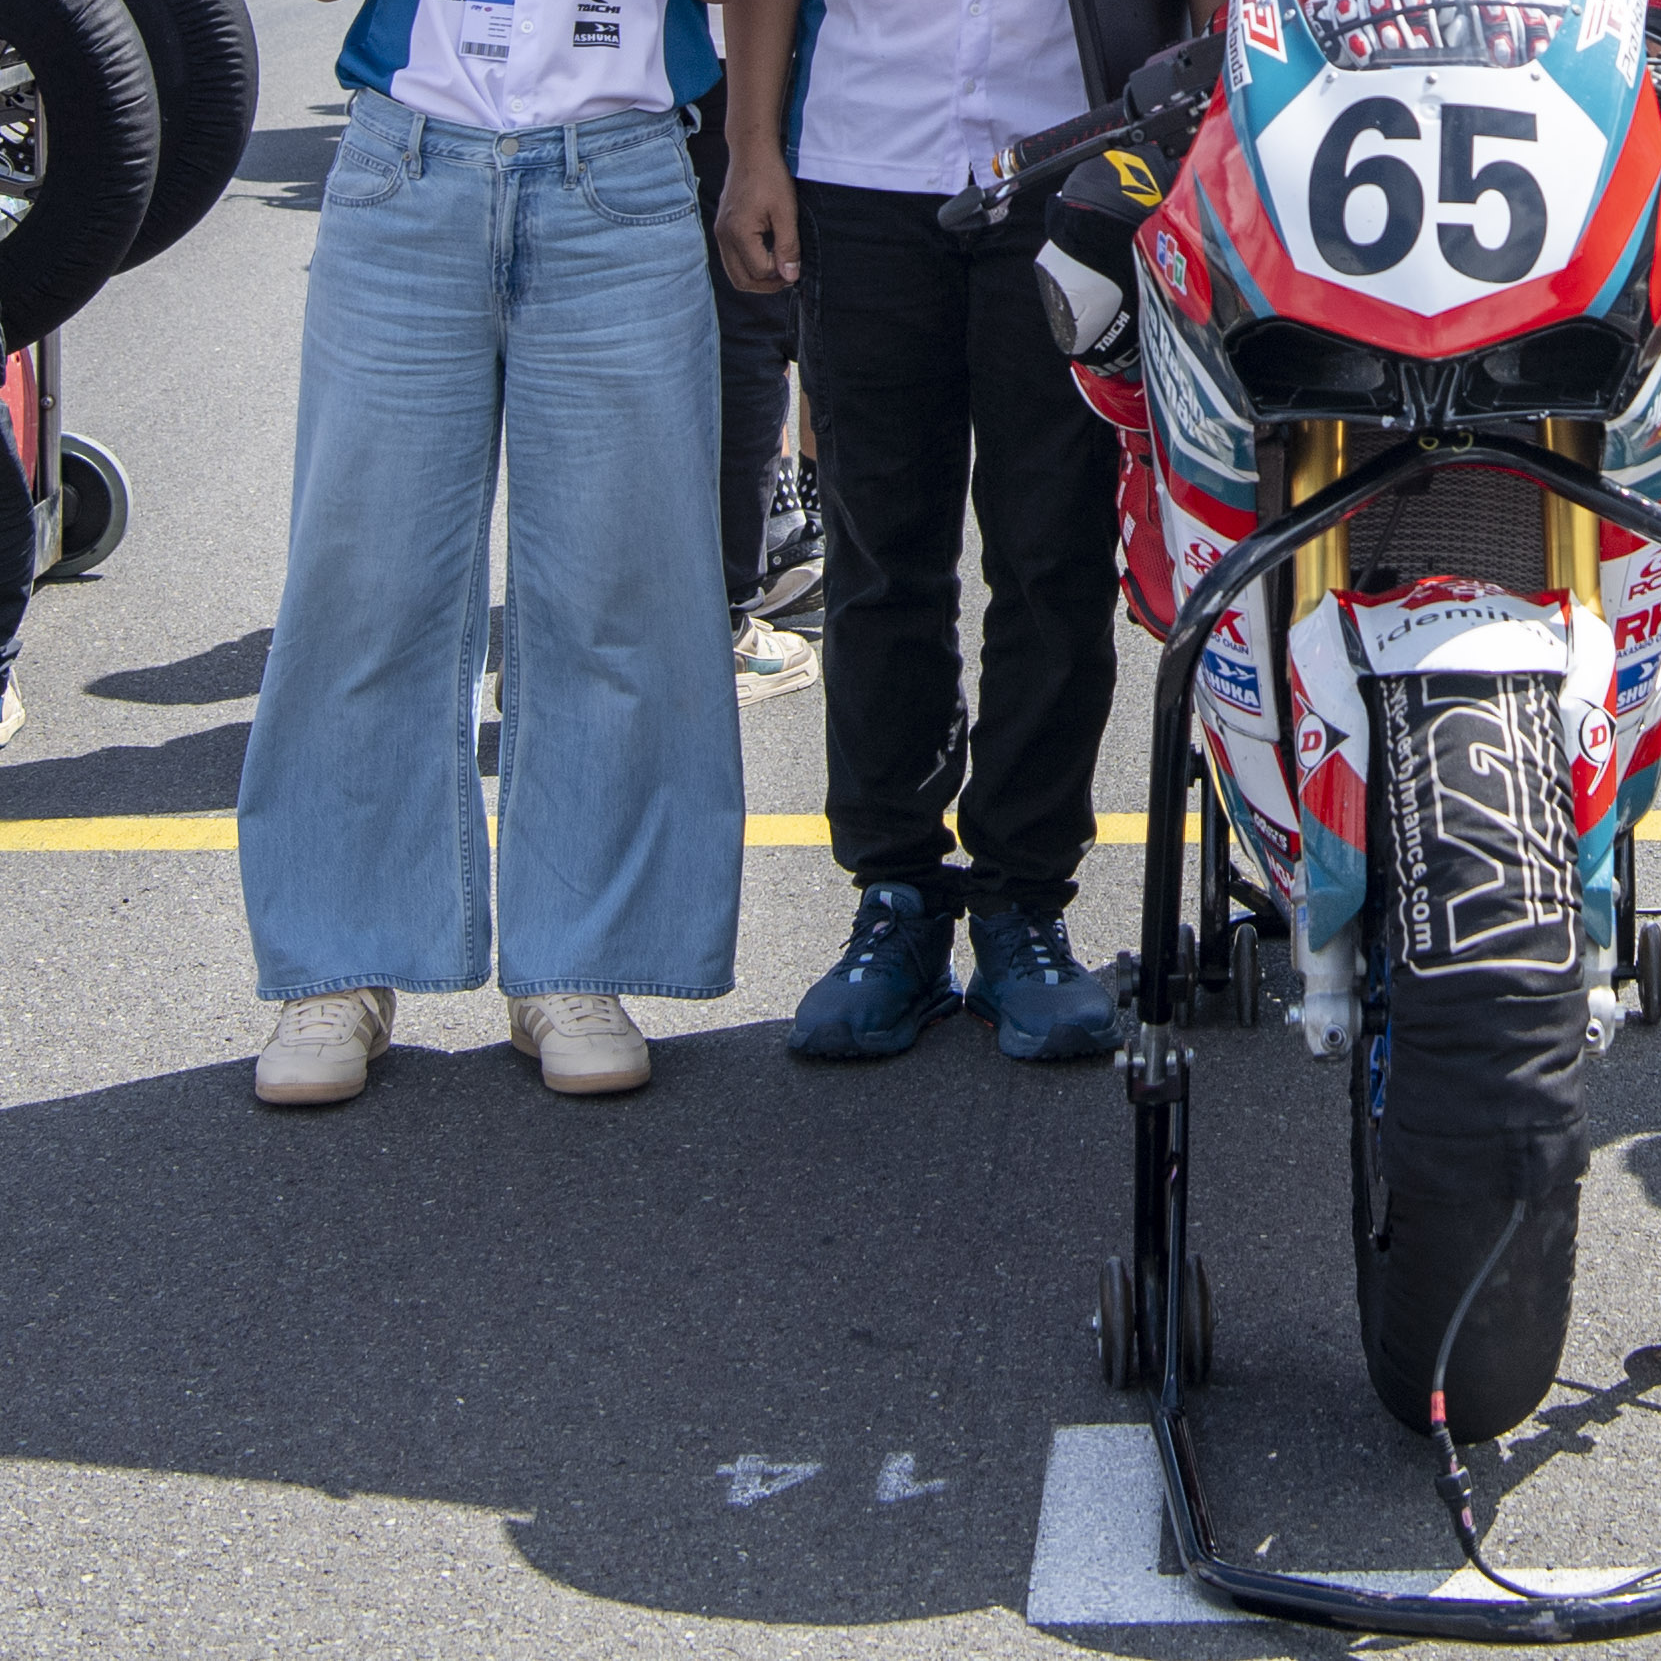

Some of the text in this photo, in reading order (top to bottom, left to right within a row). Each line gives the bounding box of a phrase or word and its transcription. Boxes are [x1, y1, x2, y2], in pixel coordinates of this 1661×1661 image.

[577, 4, 620, 14] TAICHI
[574, 33, 619, 43] ASHUKA
[1308, 96, 1548, 284] 65
[1095, 311, 1131, 352] TAICHI
[1214, 609, 1247, 646] K
